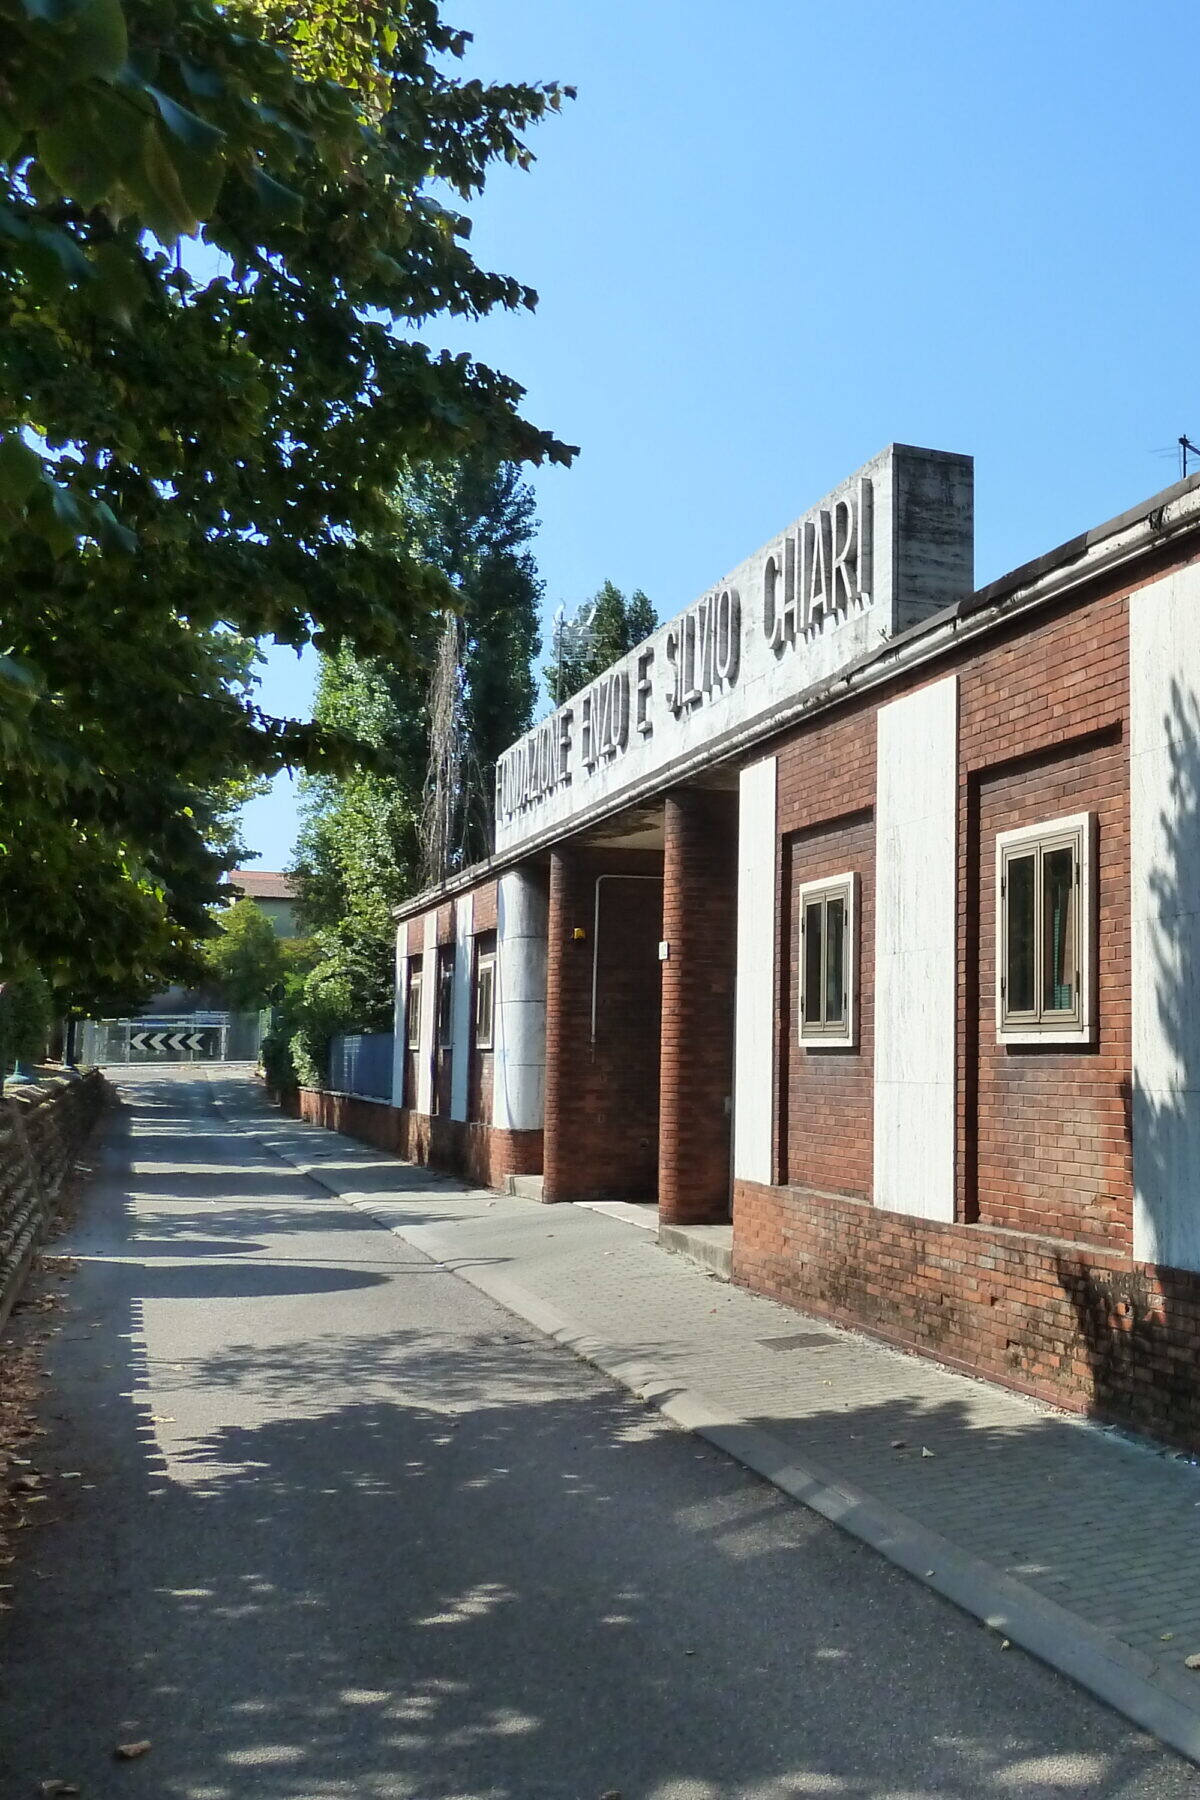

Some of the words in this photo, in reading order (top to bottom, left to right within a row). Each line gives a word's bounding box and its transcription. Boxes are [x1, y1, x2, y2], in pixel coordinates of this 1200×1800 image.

[495, 708, 573, 821] FONDAZIONE
[582, 671, 630, 768] ENZO
[637, 646, 654, 733] E
[666, 588, 741, 713] SILVIO
[763, 477, 873, 650] CHIARI
